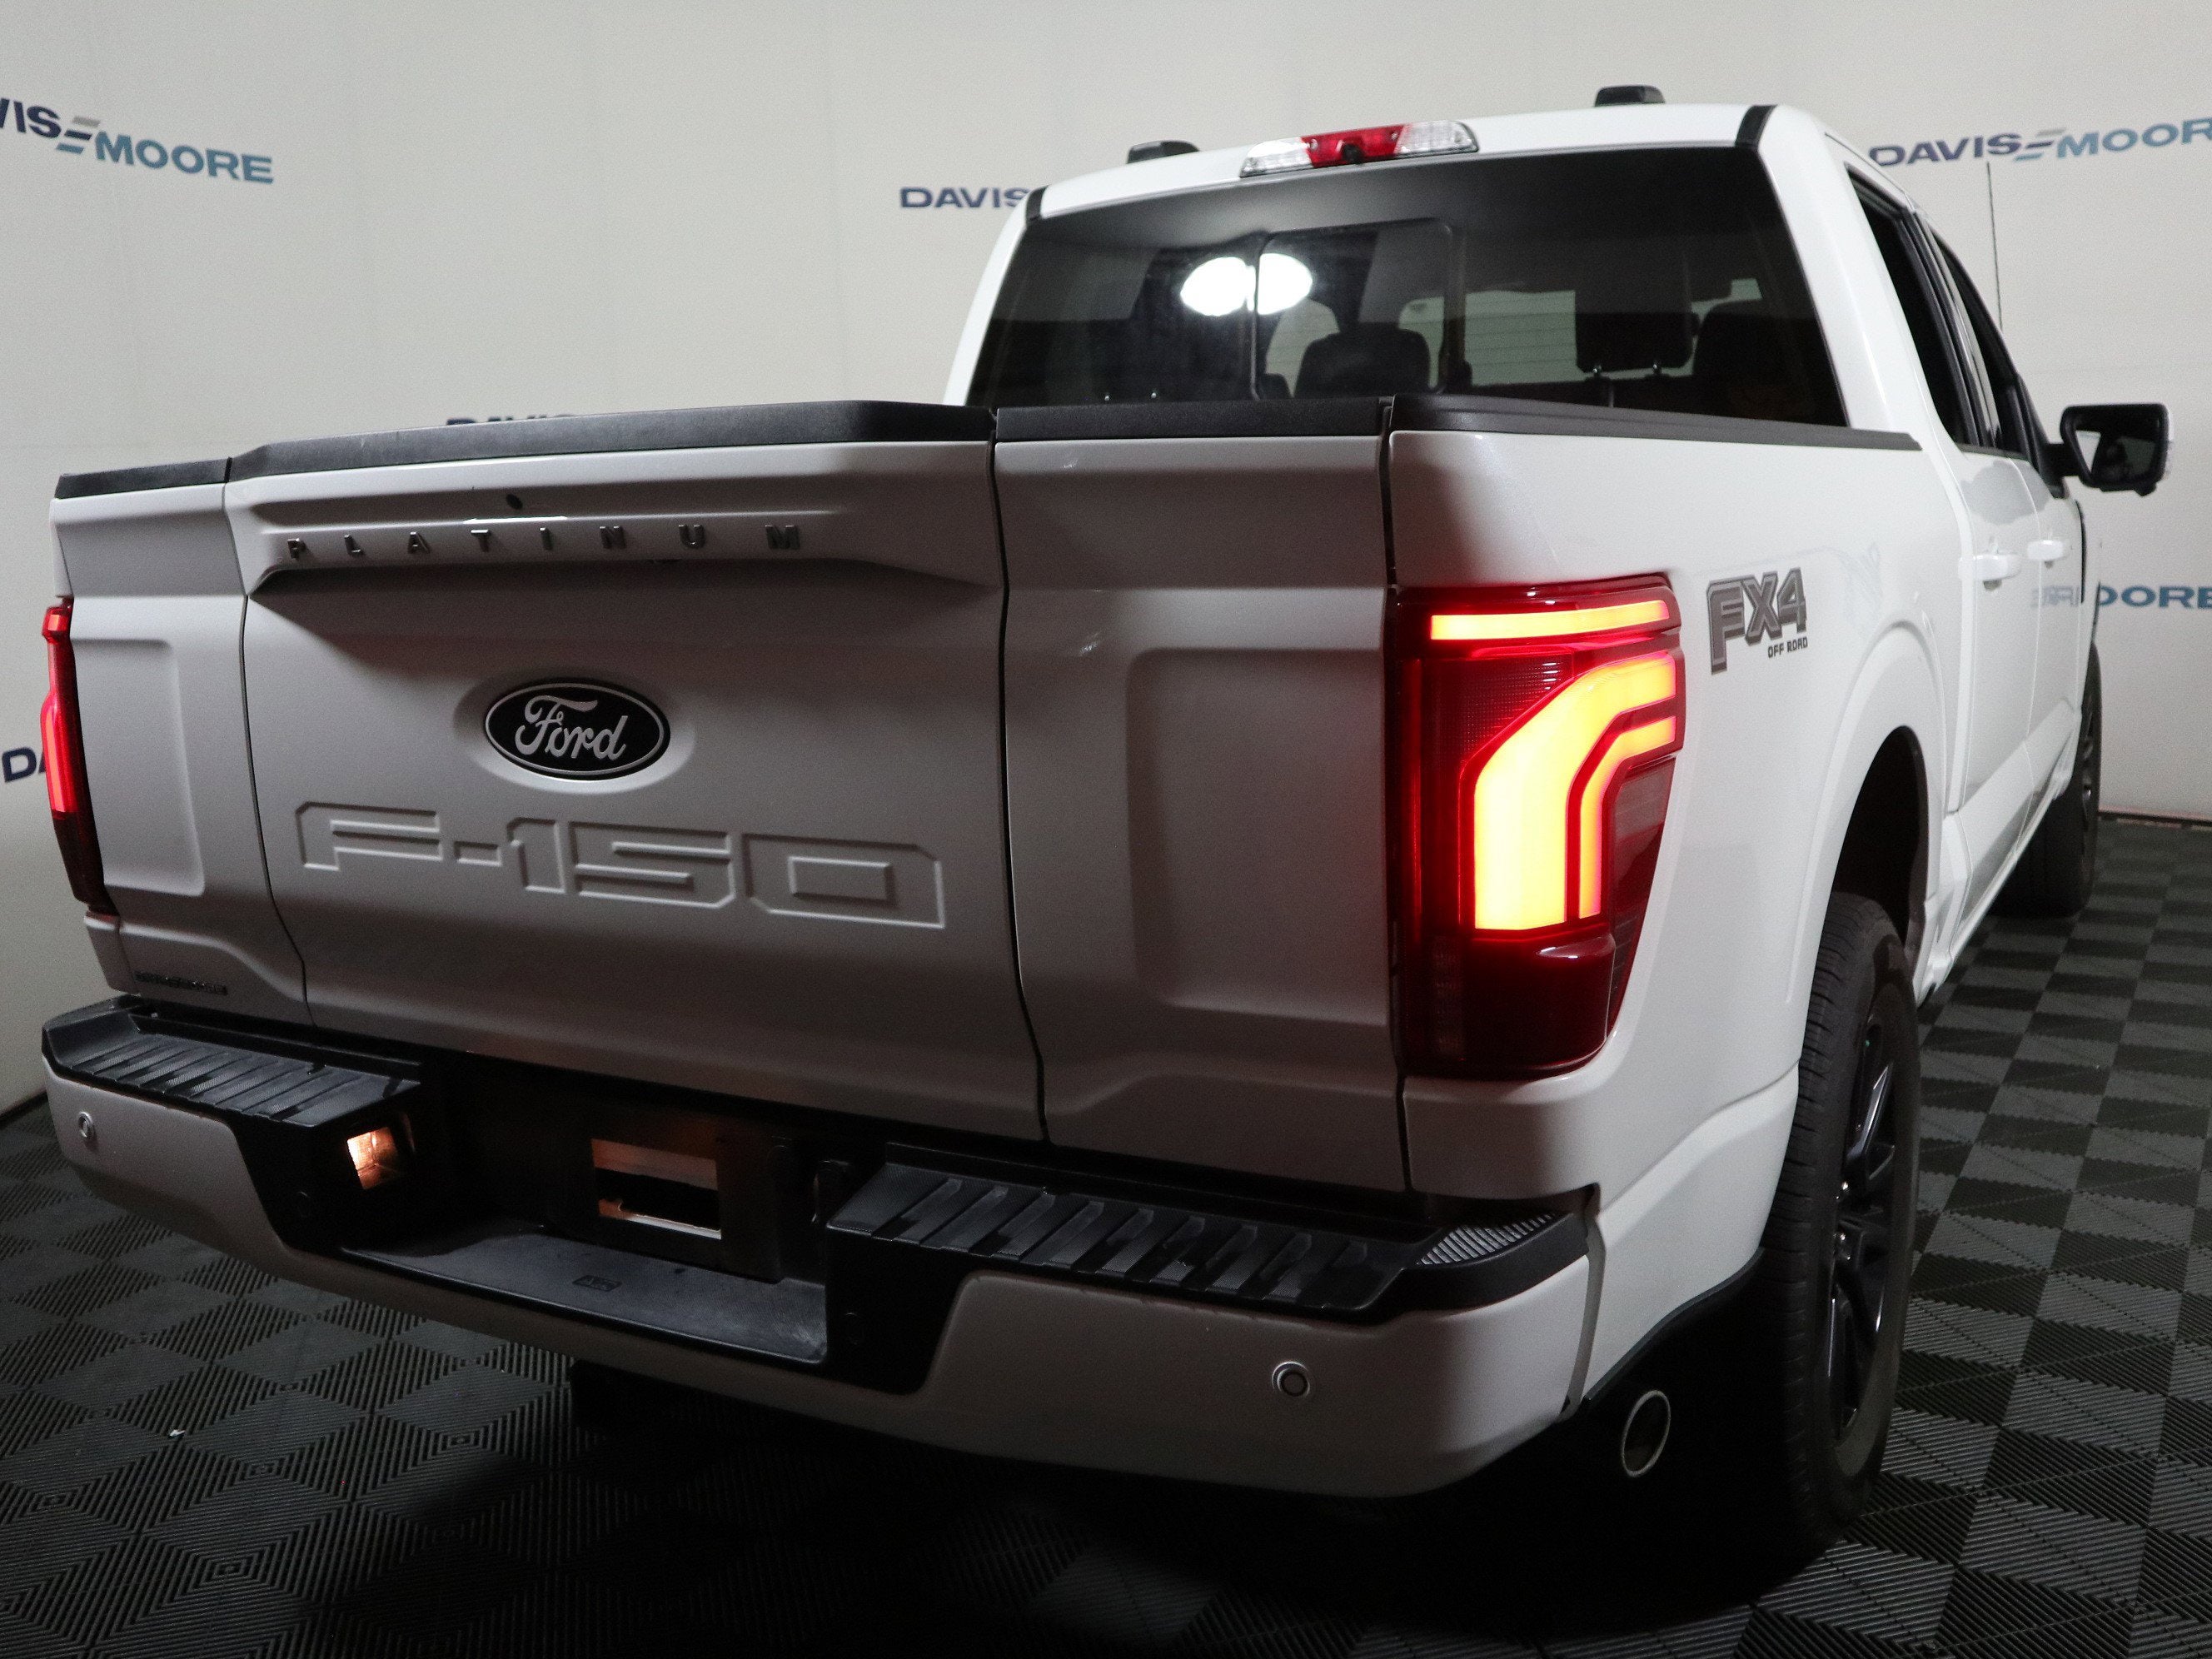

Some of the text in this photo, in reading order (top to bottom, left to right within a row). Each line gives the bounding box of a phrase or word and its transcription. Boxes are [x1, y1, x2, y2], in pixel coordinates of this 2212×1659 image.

[95, 131, 274, 184] MOORE
[1868, 132, 2022, 167] DAVIS
[900, 187, 1030, 208] DAVIS
[286, 524, 800, 559] PLATINUM
[1706, 566, 1807, 675] FX4
[1767, 635, 1808, 659] OFF ROAD
[515, 695, 629, 761] Ford
[295, 800, 945, 929] F-150
